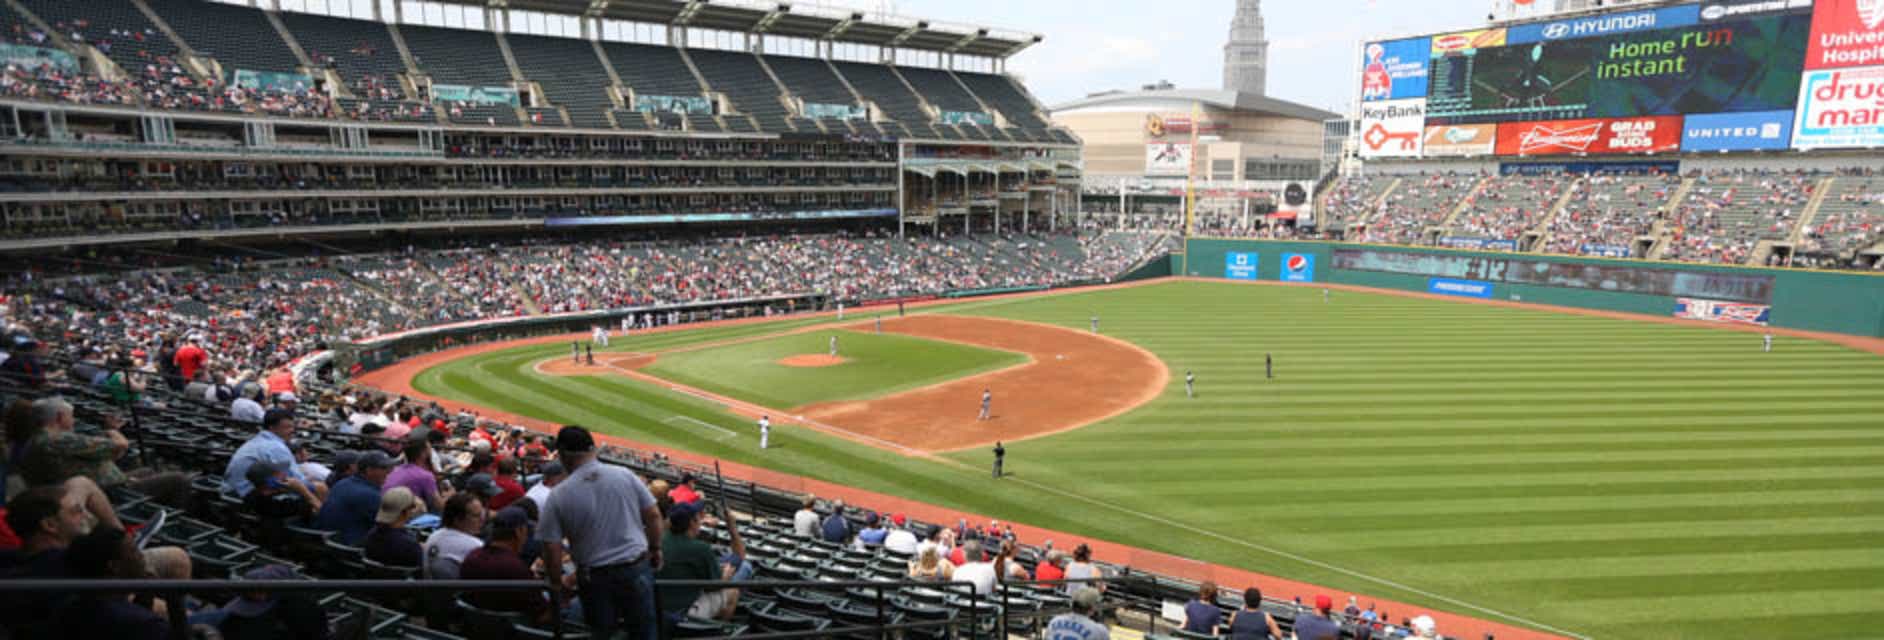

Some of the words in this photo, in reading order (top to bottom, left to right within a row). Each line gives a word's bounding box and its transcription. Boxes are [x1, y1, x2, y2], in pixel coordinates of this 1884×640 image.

[1573, 13, 1656, 35] HYUNDAI
[1609, 39, 1675, 59] Home
[1681, 27, 1732, 49] run
[1597, 56, 1686, 80] instant
[1363, 105, 1422, 121] KeyBank
[1610, 121, 1656, 132] GRAB
[1688, 127, 1758, 138] UNITED
[1608, 137, 1653, 149] BUDS
